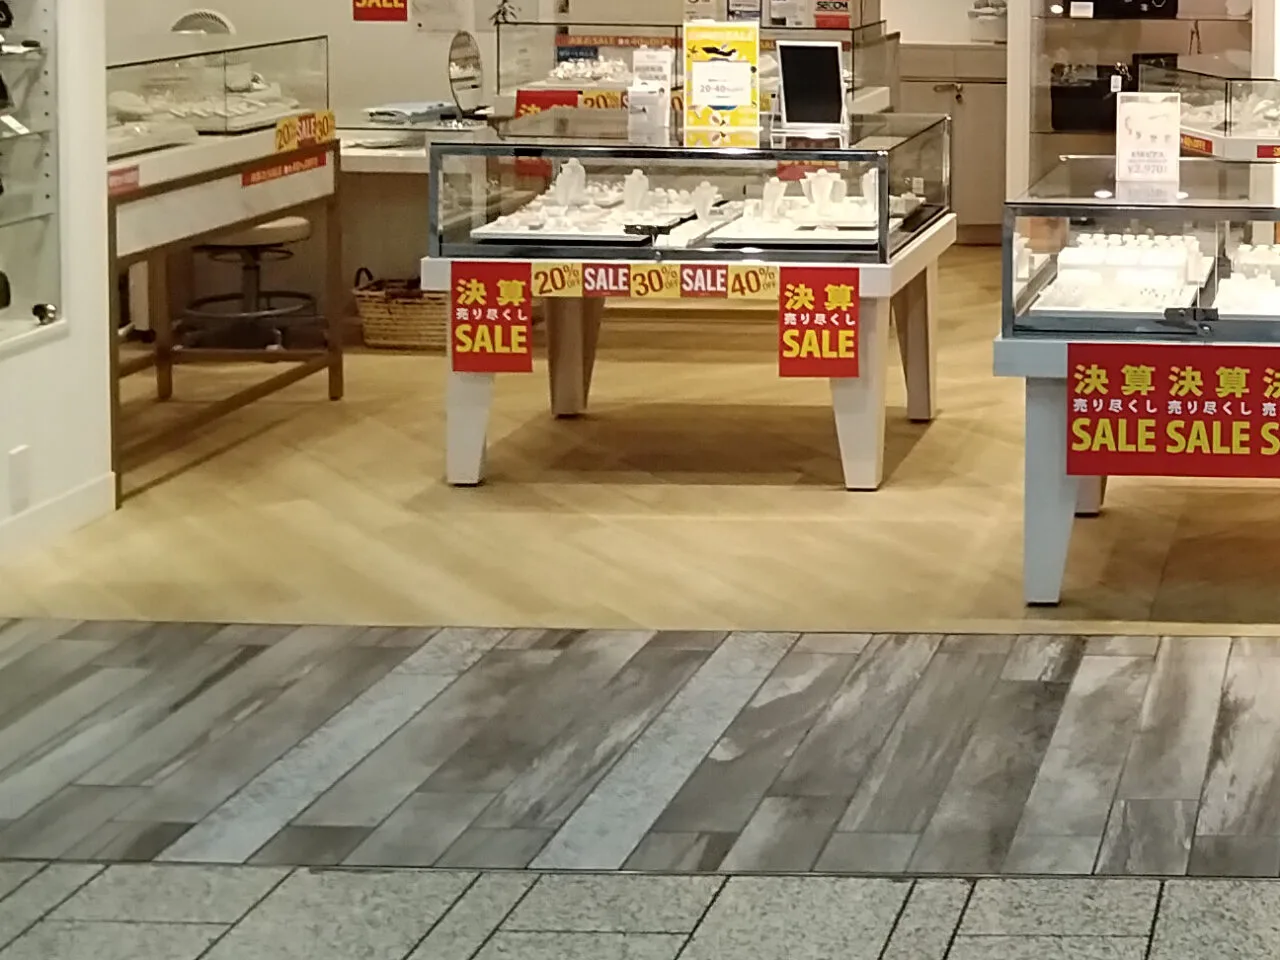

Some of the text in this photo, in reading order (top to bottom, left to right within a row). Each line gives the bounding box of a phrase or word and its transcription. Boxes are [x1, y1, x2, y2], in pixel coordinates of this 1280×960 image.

[456, 278, 527, 306] 決算
[584, 267, 629, 291] SALE
[682, 268, 727, 292] SALE
[784, 283, 854, 311] 決算
[455, 307, 528, 321] 売り尽くし
[783, 312, 856, 326] 売り尽くし
[454, 323, 528, 354] SALE
[782, 329, 855, 359] SALE
[1074, 364, 1156, 396] 決算
[1168, 366, 1251, 398] 決算
[1072, 398, 1159, 414] 売り尽くし
[1167, 400, 1253, 416] 売り尽くし
[1071, 418, 1157, 453] SALE
[1165, 420, 1251, 455] SALE
